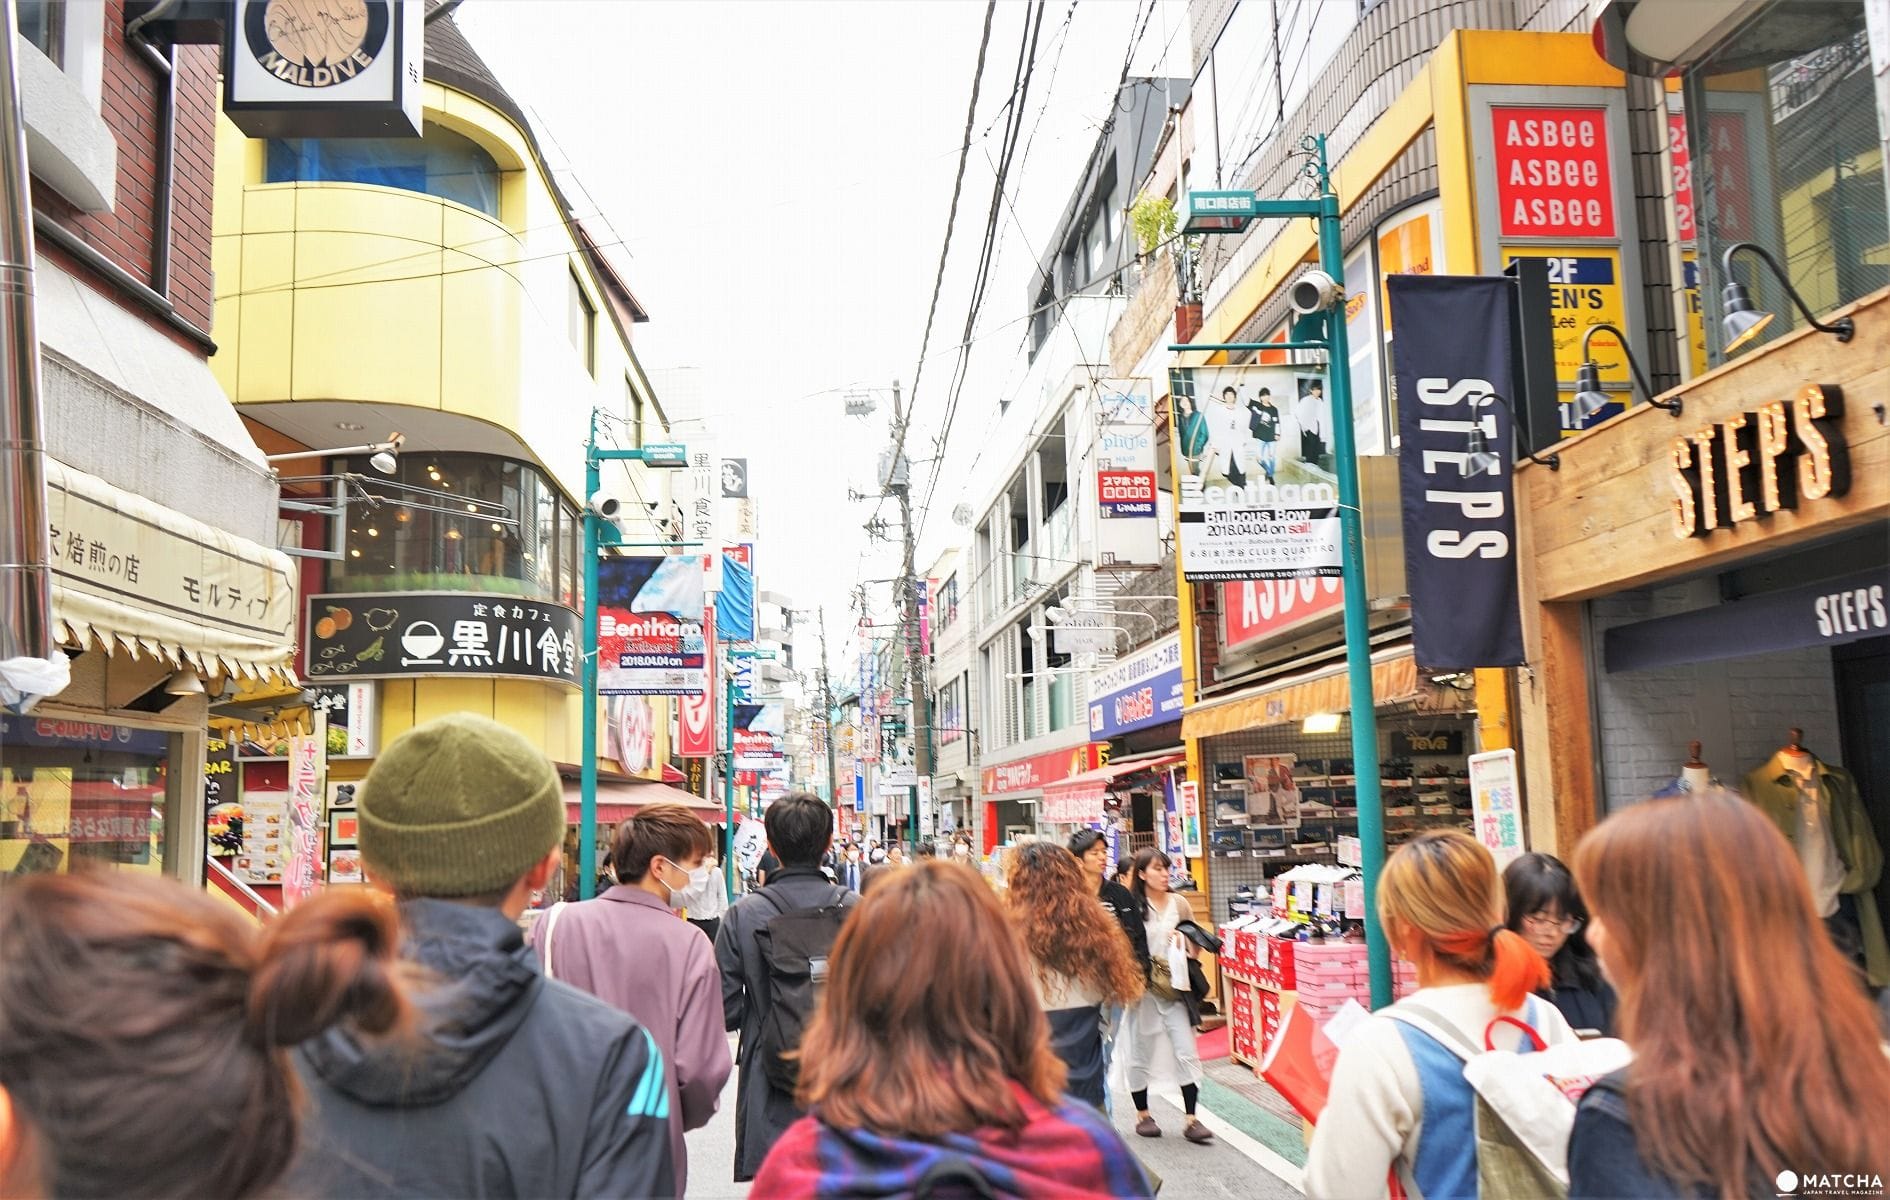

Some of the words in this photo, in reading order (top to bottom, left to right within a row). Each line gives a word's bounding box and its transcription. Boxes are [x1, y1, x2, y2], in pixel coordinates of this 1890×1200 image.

[258, 47, 374, 87] MALDIVE
[1506, 120, 1594, 148] ASBee
[1509, 159, 1598, 187] ASBee
[1513, 199, 1601, 227] ASBee
[1548, 258, 1577, 283] 2F
[1551, 288, 1603, 310] EN'S
[1416, 378, 1509, 559] STEPS
[1670, 384, 1838, 540] STEPS
[1180, 475, 1334, 505] Bentham
[1205, 510, 1272, 523] Bulbous
[1275, 509, 1311, 521] Bow
[1207, 524, 1268, 537] 2018.04.04
[1270, 526, 1286, 535] on
[473, 603, 551, 622] 定食カフェ
[1815, 584, 1888, 637] STEPS
[600, 616, 701, 637] Bentham
[448, 619, 576, 675] 黒川食堂
